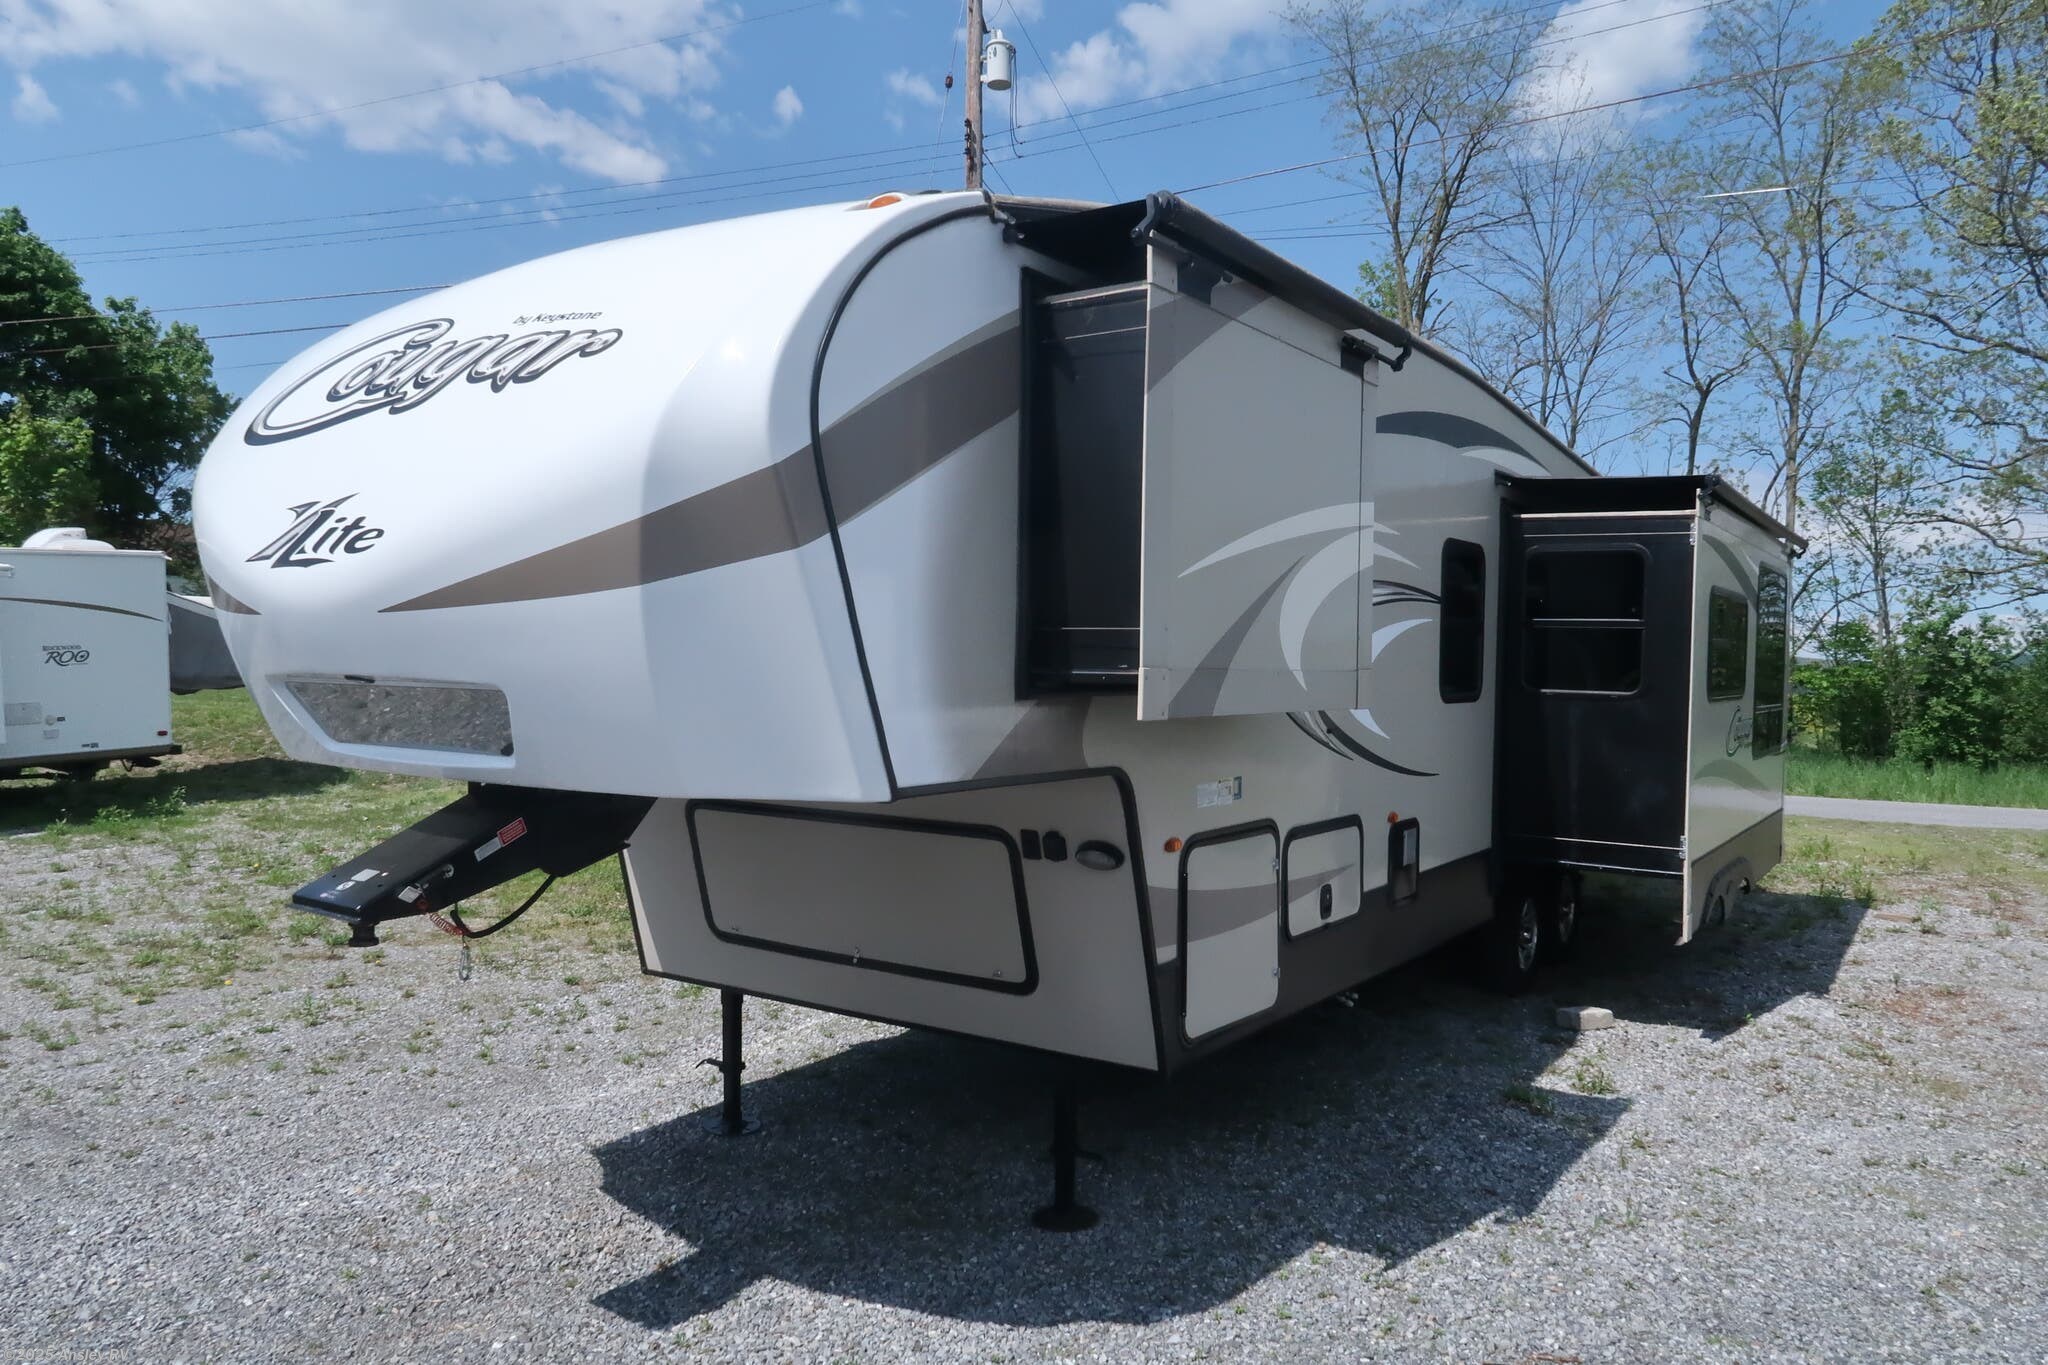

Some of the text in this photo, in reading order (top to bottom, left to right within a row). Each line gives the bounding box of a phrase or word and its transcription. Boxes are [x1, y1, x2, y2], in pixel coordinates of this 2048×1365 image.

[513, 312, 602, 327] by Keystone
[244, 318, 623, 446] Cougar
[45, 650, 90, 666] ROO
